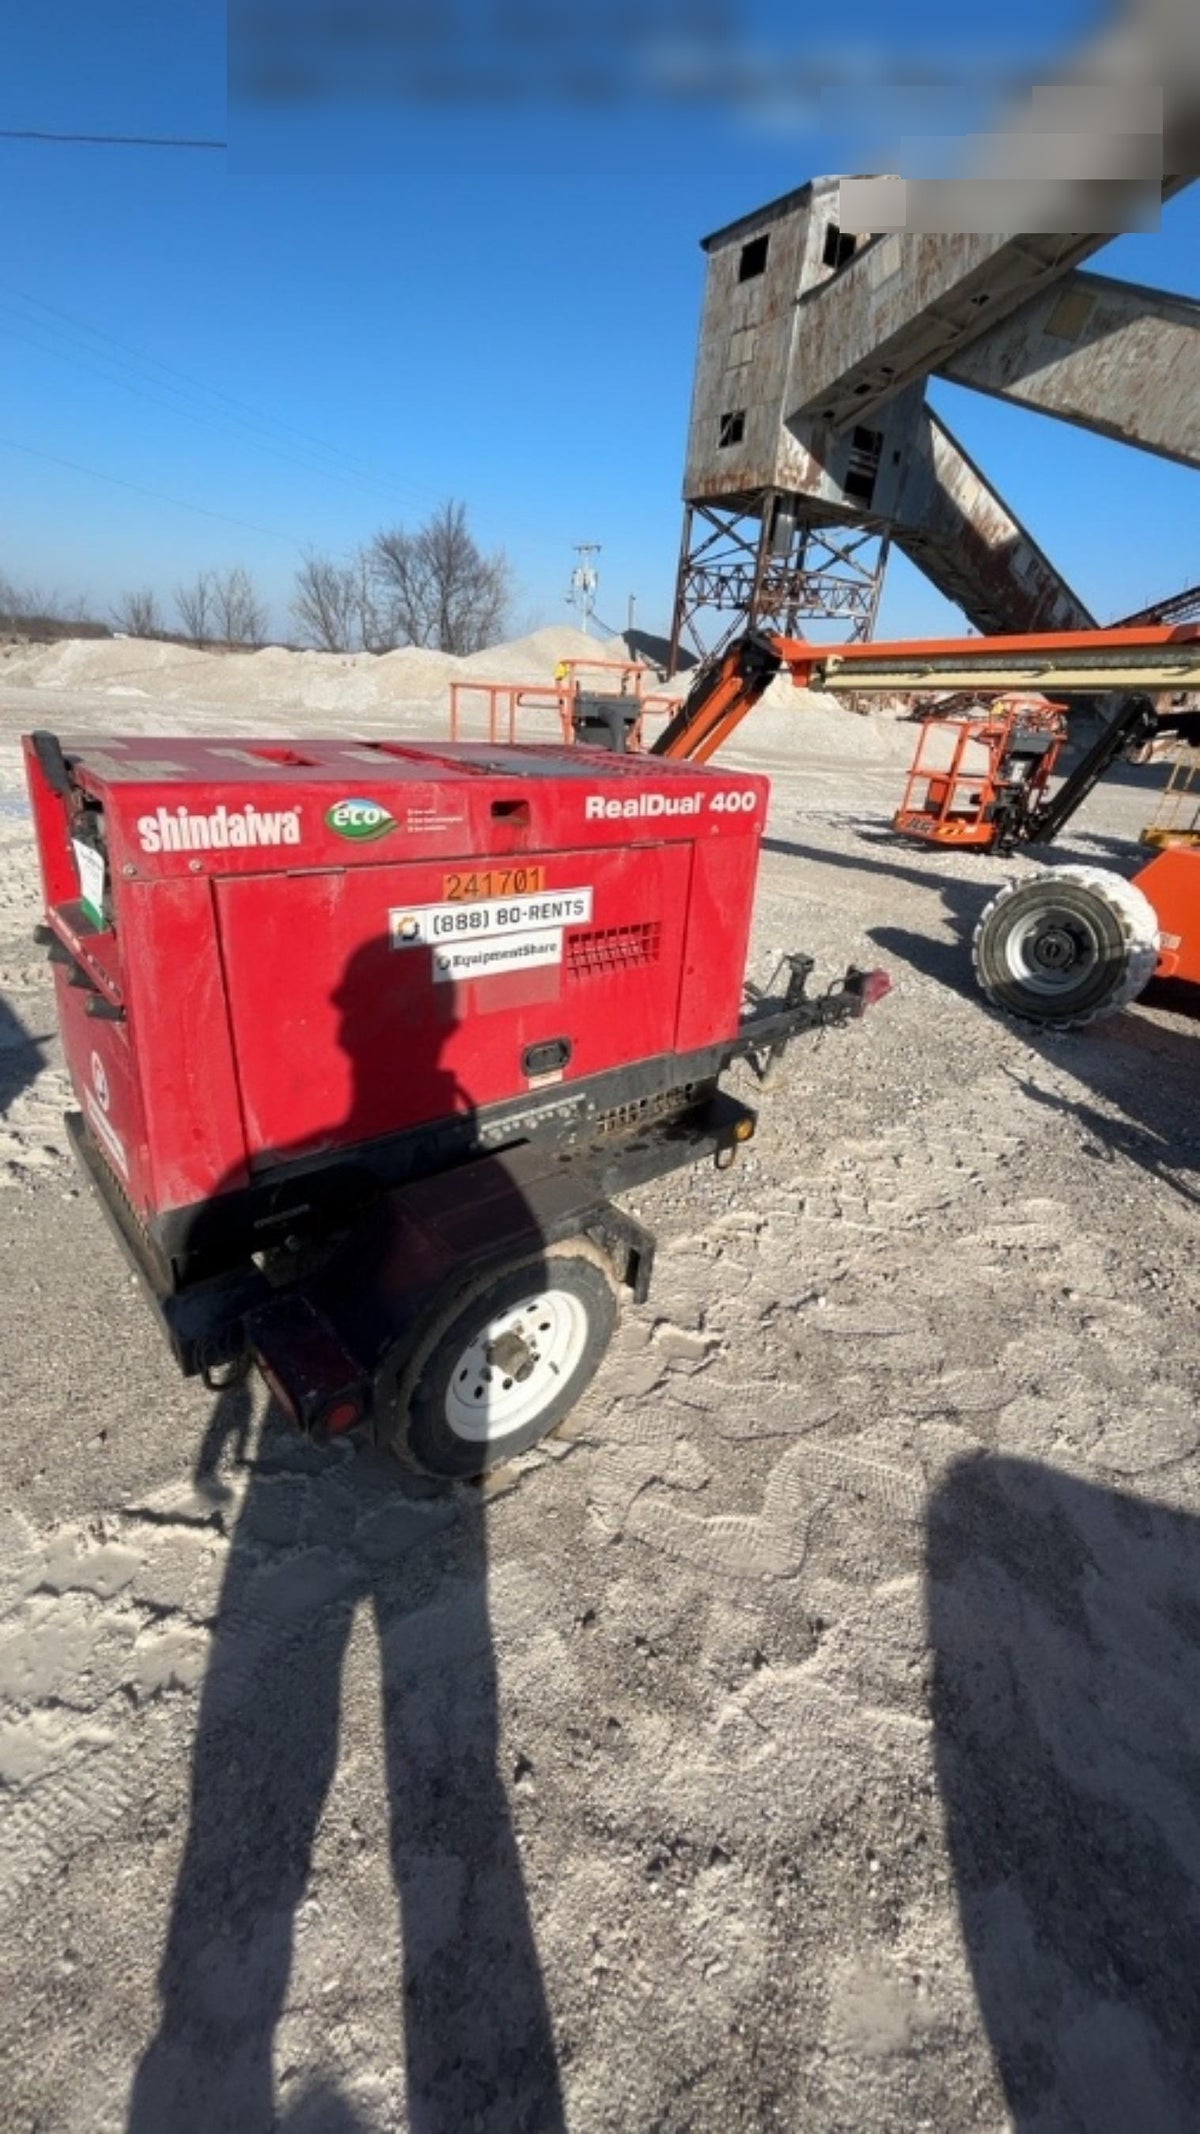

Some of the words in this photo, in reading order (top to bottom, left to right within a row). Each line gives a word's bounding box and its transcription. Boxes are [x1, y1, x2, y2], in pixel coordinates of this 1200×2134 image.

[585, 792, 701, 819] RealDual
[709, 791, 756, 812] 400
[137, 804, 300, 852] shindaiwa
[447, 867, 541, 900] 241701
[433, 911, 490, 935] (888)
[496, 900, 584, 925] 80-RENTS
[453, 942, 557, 967] EquipmentShare
